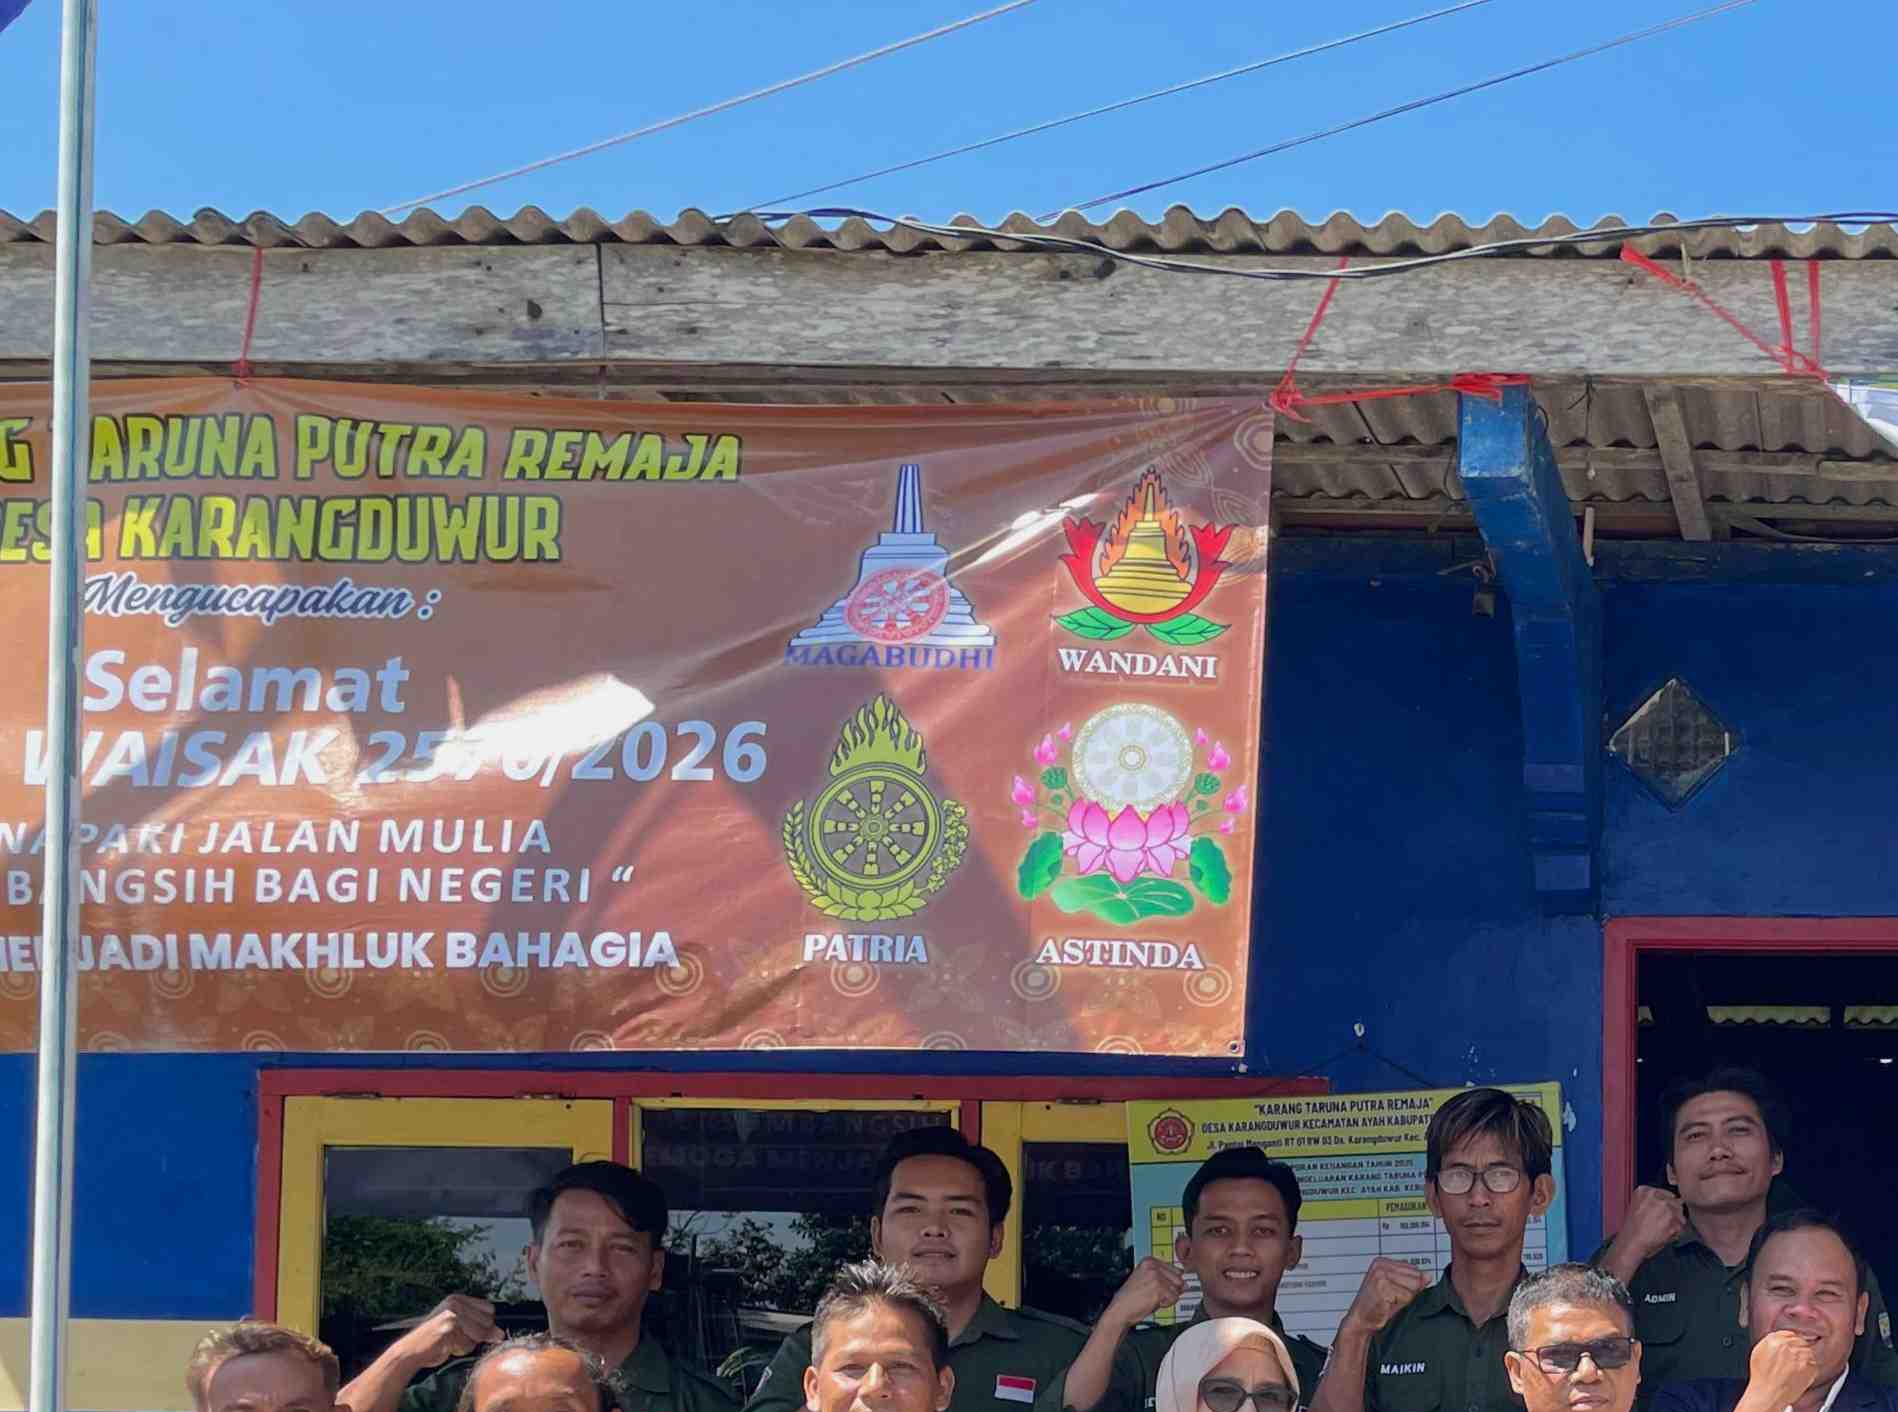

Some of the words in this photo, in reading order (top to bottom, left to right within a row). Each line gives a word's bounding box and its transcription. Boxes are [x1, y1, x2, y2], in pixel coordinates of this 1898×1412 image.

[48, 413, 279, 482] ARUNA
[295, 413, 487, 482] PUTRA
[503, 428, 743, 482] REMAJA
[119, 494, 562, 564] KARANGDUWUR
[83, 570, 413, 627] Mengucapakan
[785, 642, 996, 671] MAGABUDHI
[1057, 647, 1219, 680] WANDANI
[82, 647, 411, 715] Selamat
[199, 820, 361, 855] JALAN
[379, 820, 552, 855] MULIA
[7, 867, 236, 905] BNGSIH
[255, 866, 380, 903] BAGI
[398, 866, 591, 902] NEGERI
[189, 932, 434, 971] MAKHLUK
[445, 931, 682, 971] BAHAGIA
[803, 933, 929, 964] PATRIA
[1034, 938, 1206, 971] ASTINDA
[1306, 1101, 1345, 1114] TARUNA
[1350, 1099, 1384, 1112] PUTRA
[1201, 1121, 1226, 1134] DESA
[1228, 1119, 1302, 1133] KARANGDUWUR
[1303, 1117, 1359, 1130] KECAMATAN
[1361, 1115, 1386, 1128] AYAH
[1380, 1362, 1425, 1375] MAIKIN
